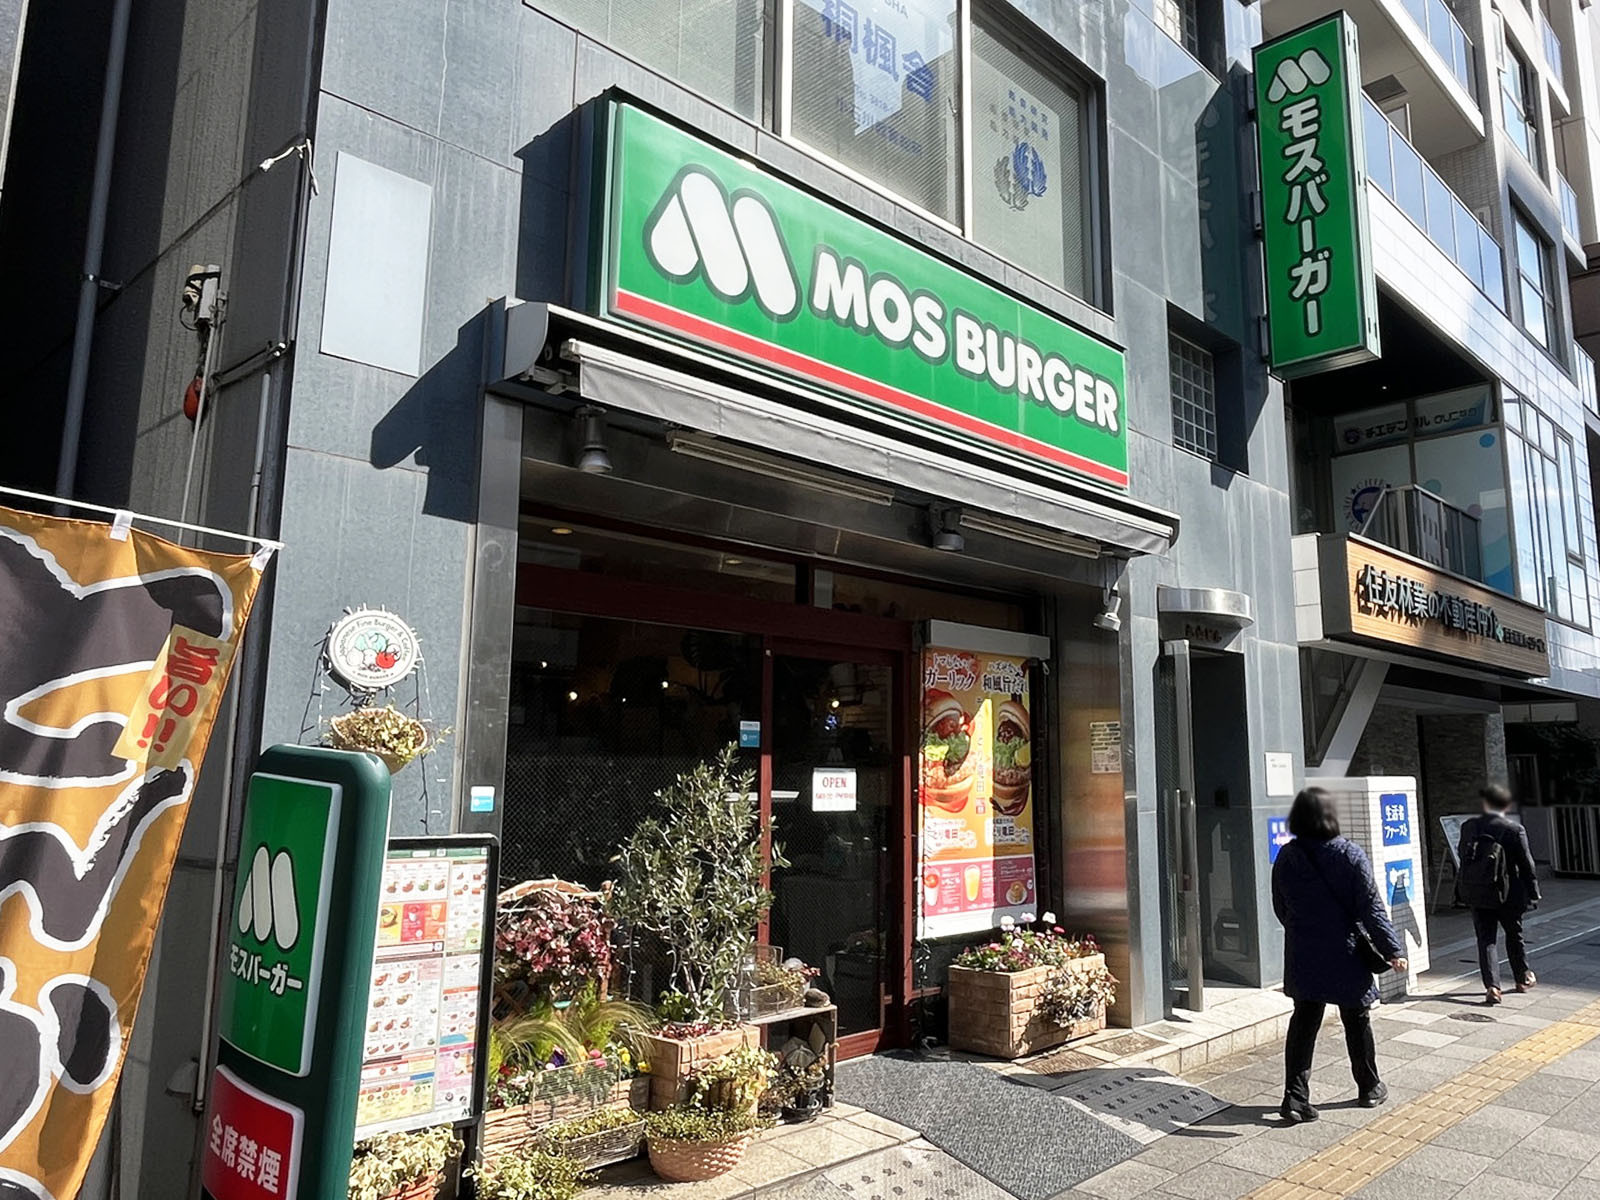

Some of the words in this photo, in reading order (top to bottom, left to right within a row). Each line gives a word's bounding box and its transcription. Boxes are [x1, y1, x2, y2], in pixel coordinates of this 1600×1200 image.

[1281, 97, 1329, 335] モスバーガー
[813, 251, 947, 361] MOS
[956, 322, 1120, 433] BURGER
[373, 618, 399, 633] Burger
[925, 667, 976, 690] ガーリック
[822, 776, 848, 789] OPEN
[1385, 804, 1405, 822] 生活者
[228, 943, 303, 996] モスバーガー
[208, 1112, 284, 1194] 全席禁煙
